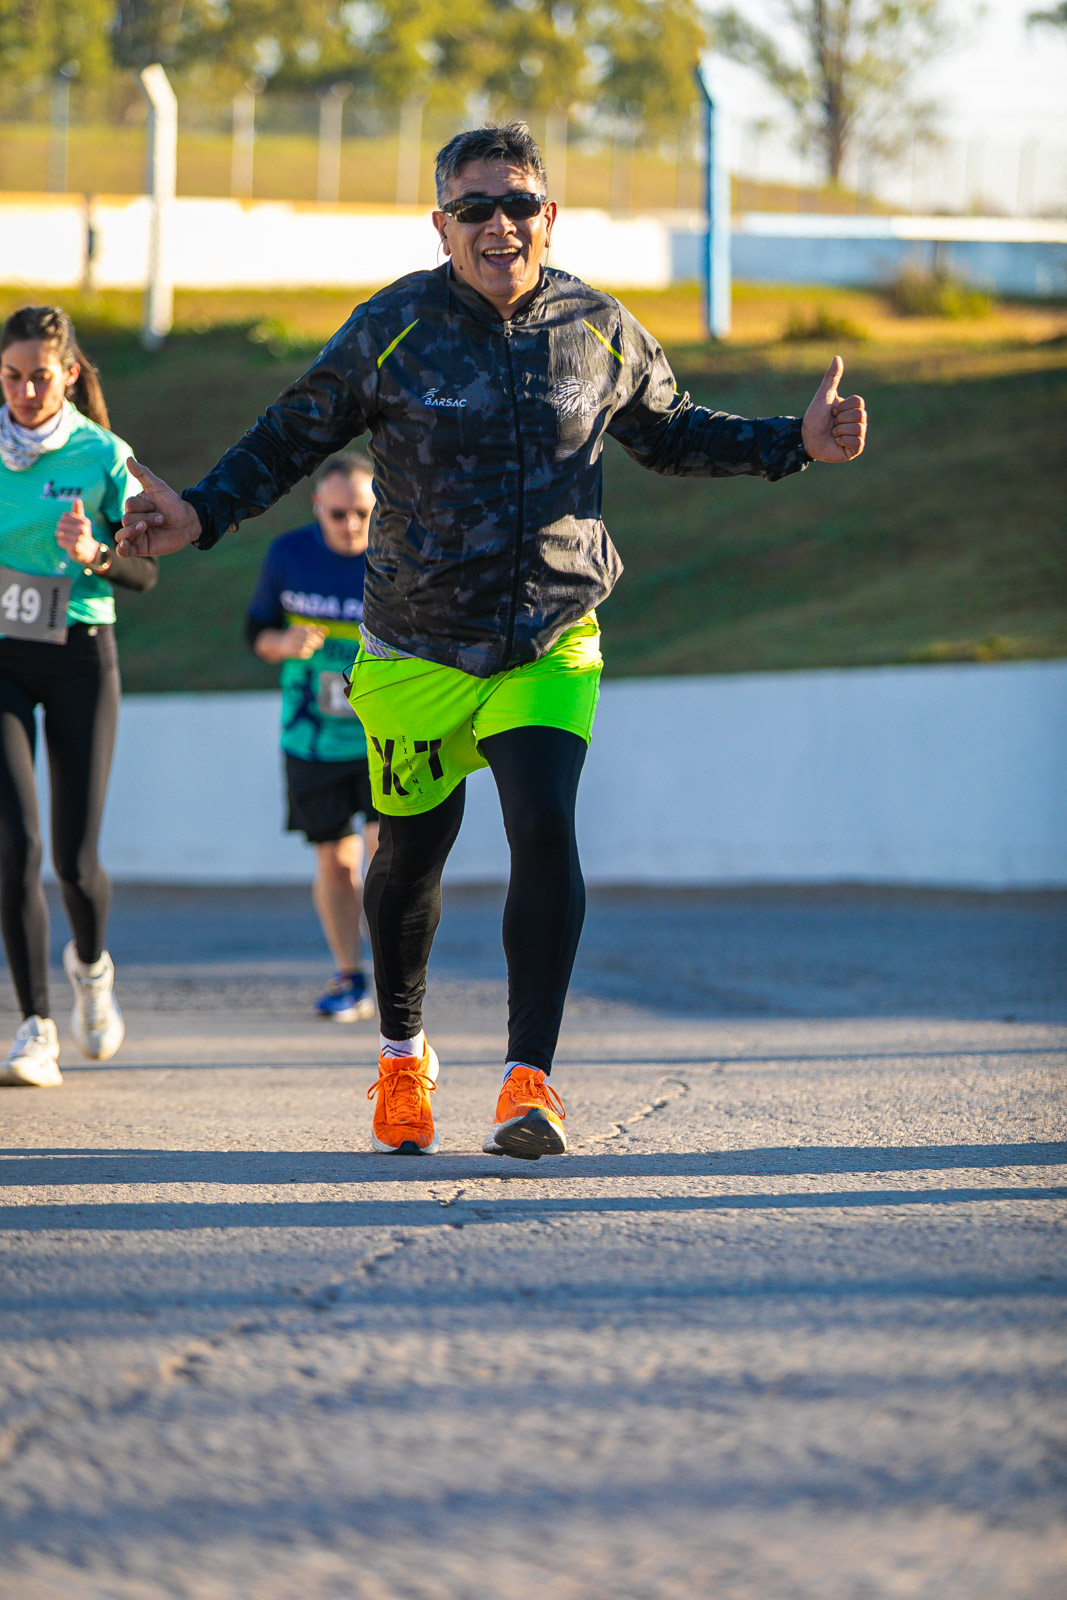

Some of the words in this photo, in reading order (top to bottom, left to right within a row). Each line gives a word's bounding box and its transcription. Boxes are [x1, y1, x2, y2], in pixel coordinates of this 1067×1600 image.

[424, 397, 467, 408] BARSAC
[1, 583, 42, 624] 49
[402, 735, 424, 795] EXTRME
